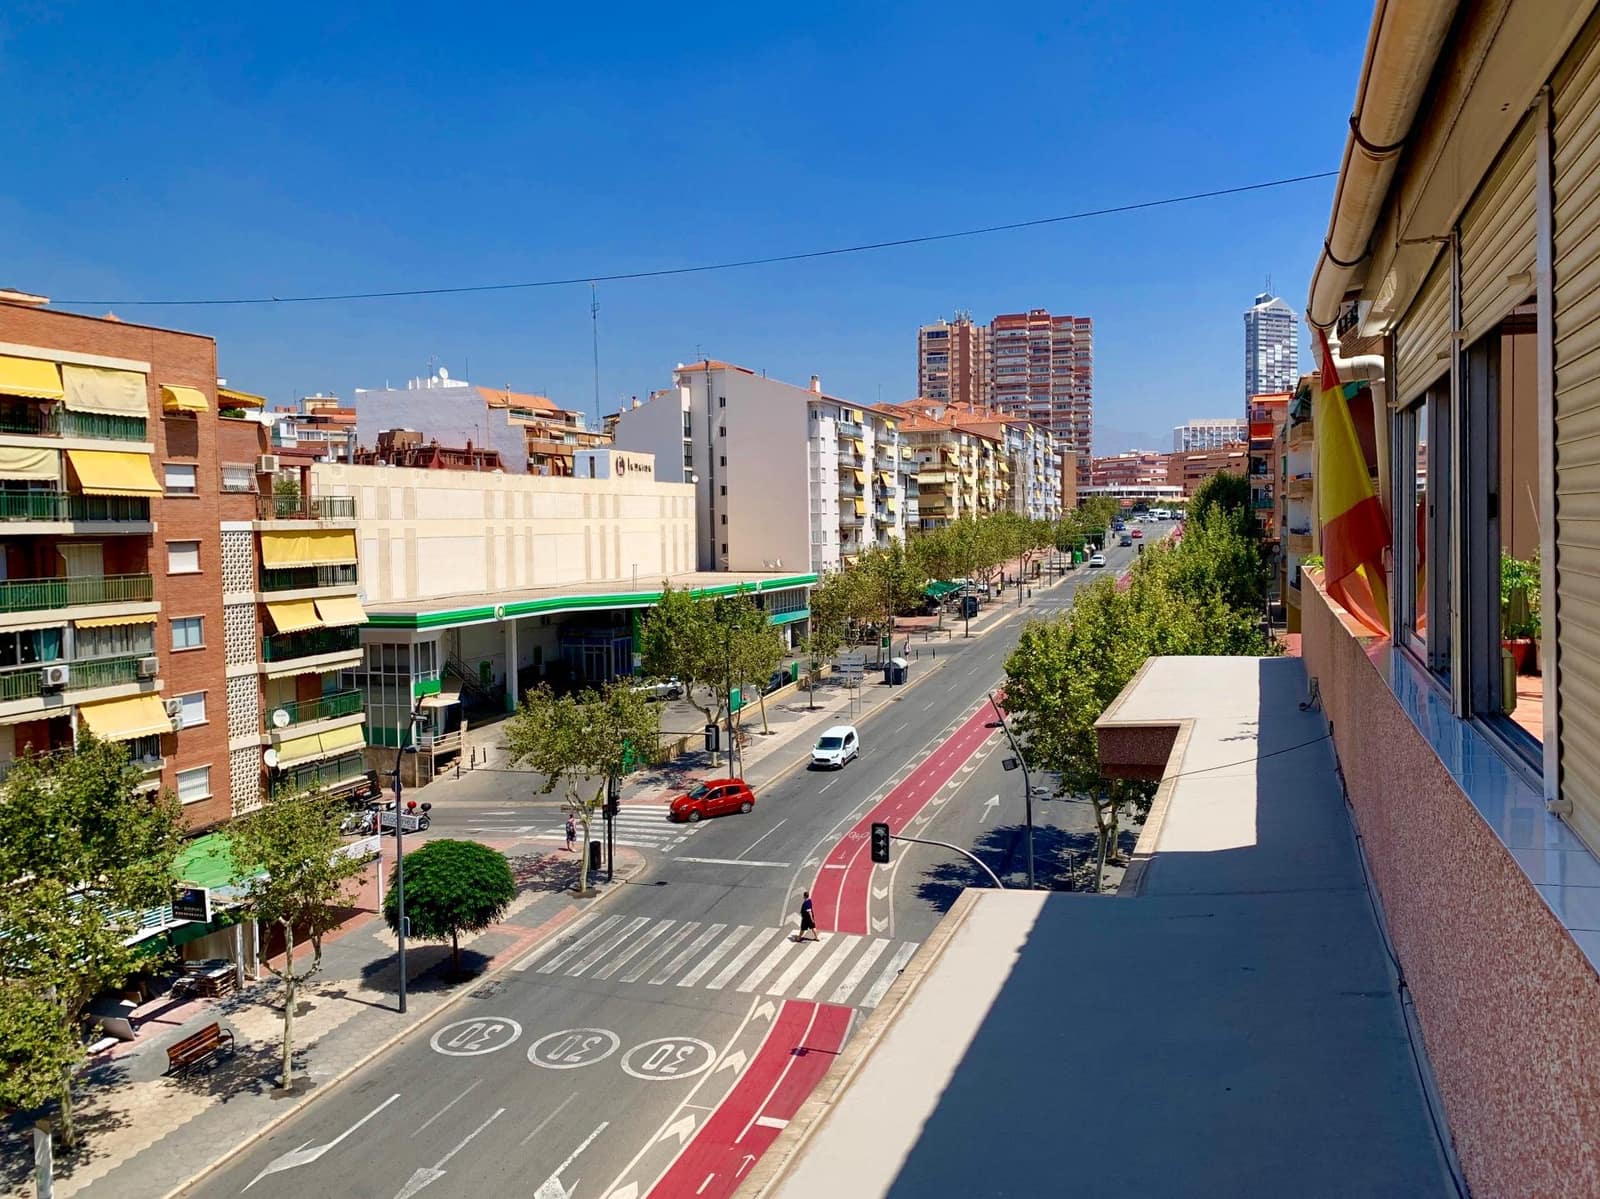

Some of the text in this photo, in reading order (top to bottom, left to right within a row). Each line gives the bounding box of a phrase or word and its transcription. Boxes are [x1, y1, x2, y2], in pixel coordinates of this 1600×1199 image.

[447, 1022, 504, 1050] 30
[547, 1034, 602, 1062] 30
[641, 1044, 696, 1073] 30
